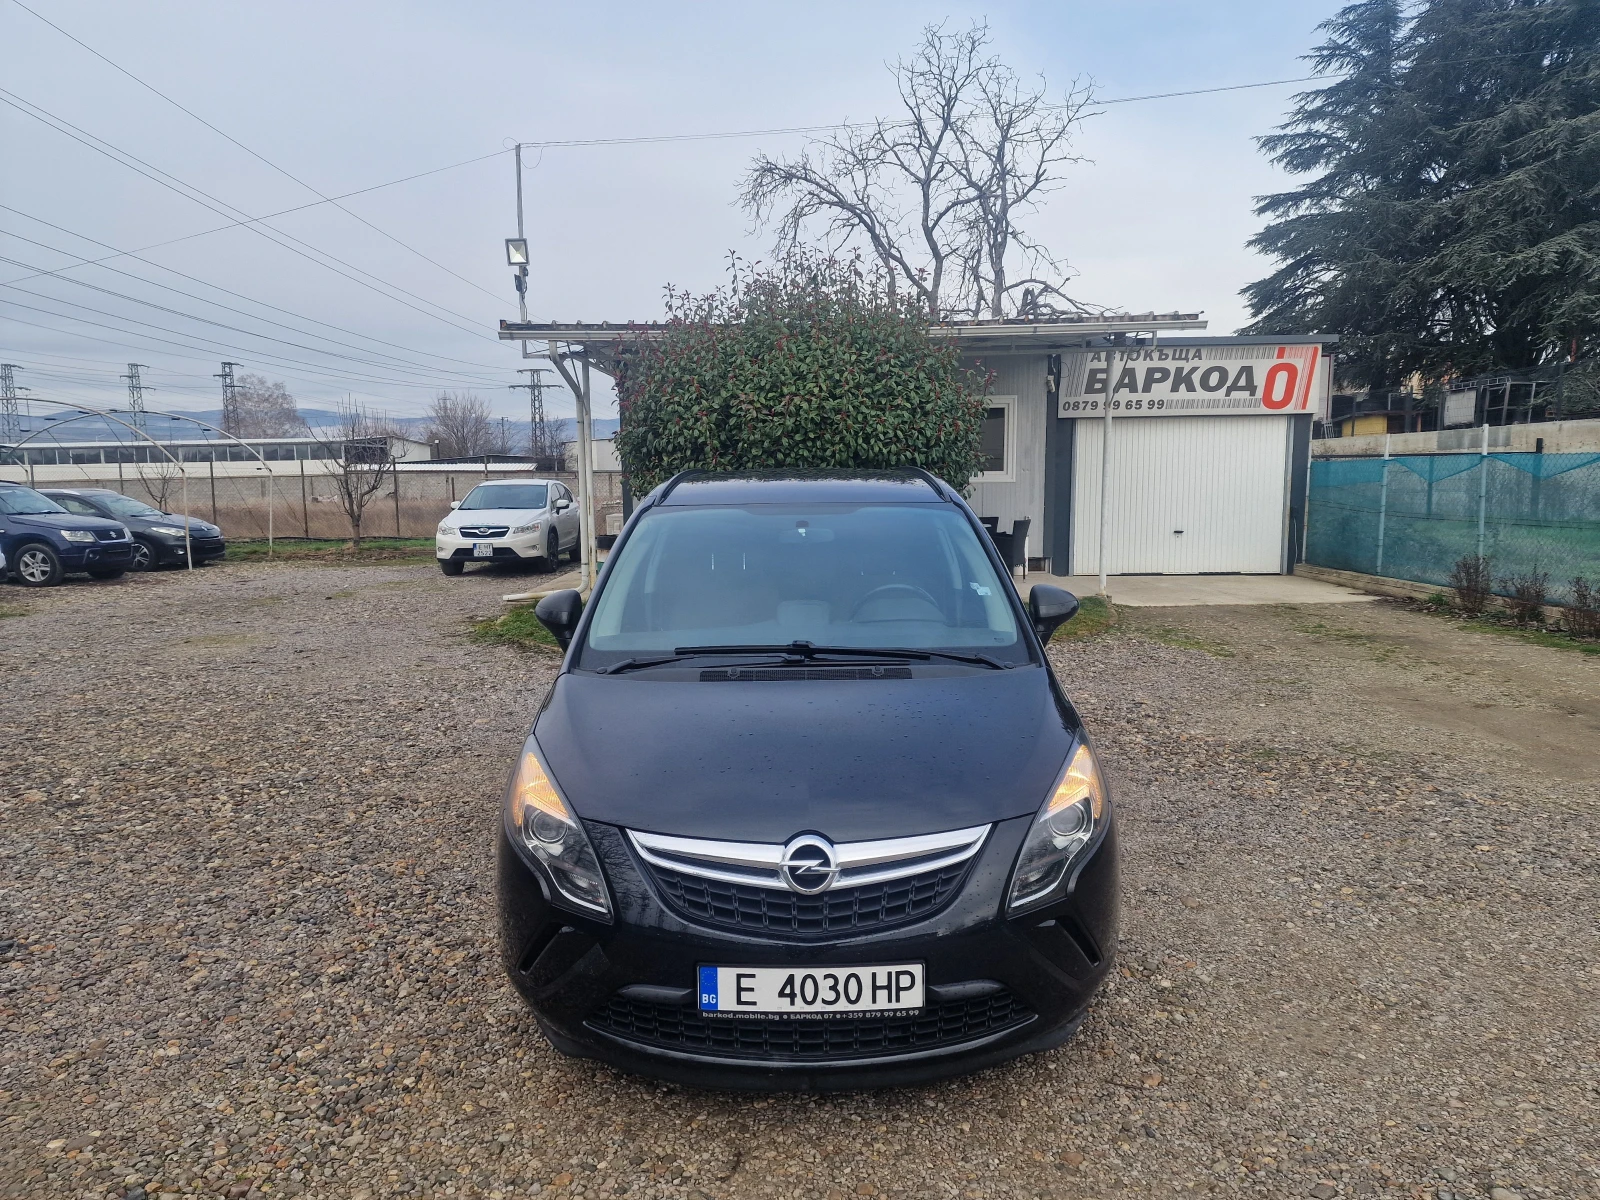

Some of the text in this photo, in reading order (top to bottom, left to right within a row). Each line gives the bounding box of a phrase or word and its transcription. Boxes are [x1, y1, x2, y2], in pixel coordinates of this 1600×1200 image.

[1084, 366, 1258, 397] БАРКОД
[1062, 400, 1099, 411] 0879
[1125, 399, 1143, 410] 65
[1147, 399, 1165, 410] 99
[736, 970, 916, 1006] E 4030 HP
[702, 994, 716, 1004] BG
[702, 1011, 780, 1020] barkod.mobile.bg
